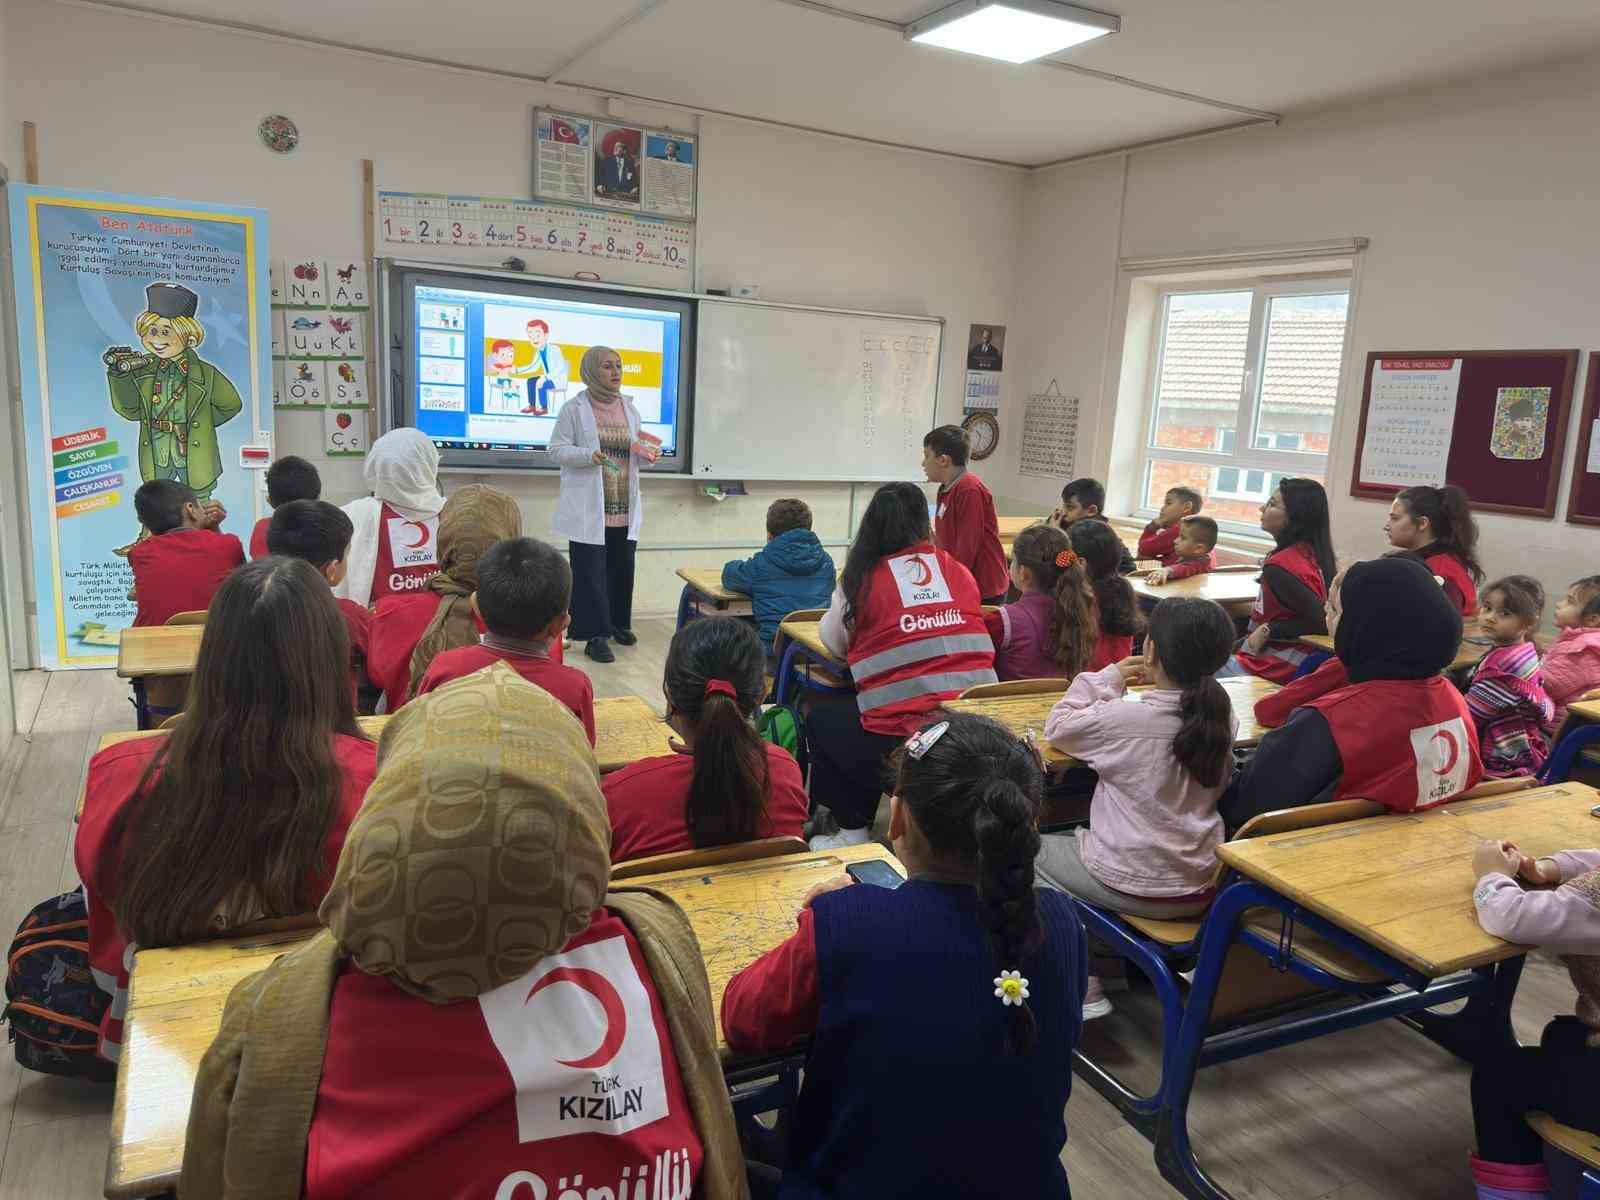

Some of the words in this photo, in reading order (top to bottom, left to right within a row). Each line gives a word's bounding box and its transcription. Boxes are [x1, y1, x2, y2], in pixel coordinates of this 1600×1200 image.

[101, 216, 128, 230] Ben
[384, 218, 391, 236] 1
[419, 220, 429, 237] 2
[452, 222, 463, 239] 3
[486, 224, 497, 241] 4
[516, 225, 527, 242] 5
[547, 229, 557, 244] 6
[578, 232, 587, 247] 7
[606, 237, 615, 252] 8
[635, 241, 645, 257] 9
[664, 246, 678, 262] 10
[292, 284, 305, 298] N
[312, 290, 320, 298] n
[336, 286, 348, 299] A
[354, 291, 362, 300] a
[294, 335, 306, 350] U
[314, 341, 322, 350] u
[330, 336, 341, 350] K
[349, 337, 356, 350] k
[337, 385, 347, 398] S
[355, 389, 361, 398] s
[331, 433, 344, 448] Ç
[350, 437, 358, 447] ç
[69, 449, 96, 462] SAYGI
[68, 463, 112, 480] ÖZGÜVEN
[103, 561, 129, 569] Milleti
[95, 609, 137, 619] geleceğimi
[900, 608, 966, 633] Gönüllü
[592, 1075, 622, 1094] TÜRK
[559, 1086, 644, 1121] KIZILAY
